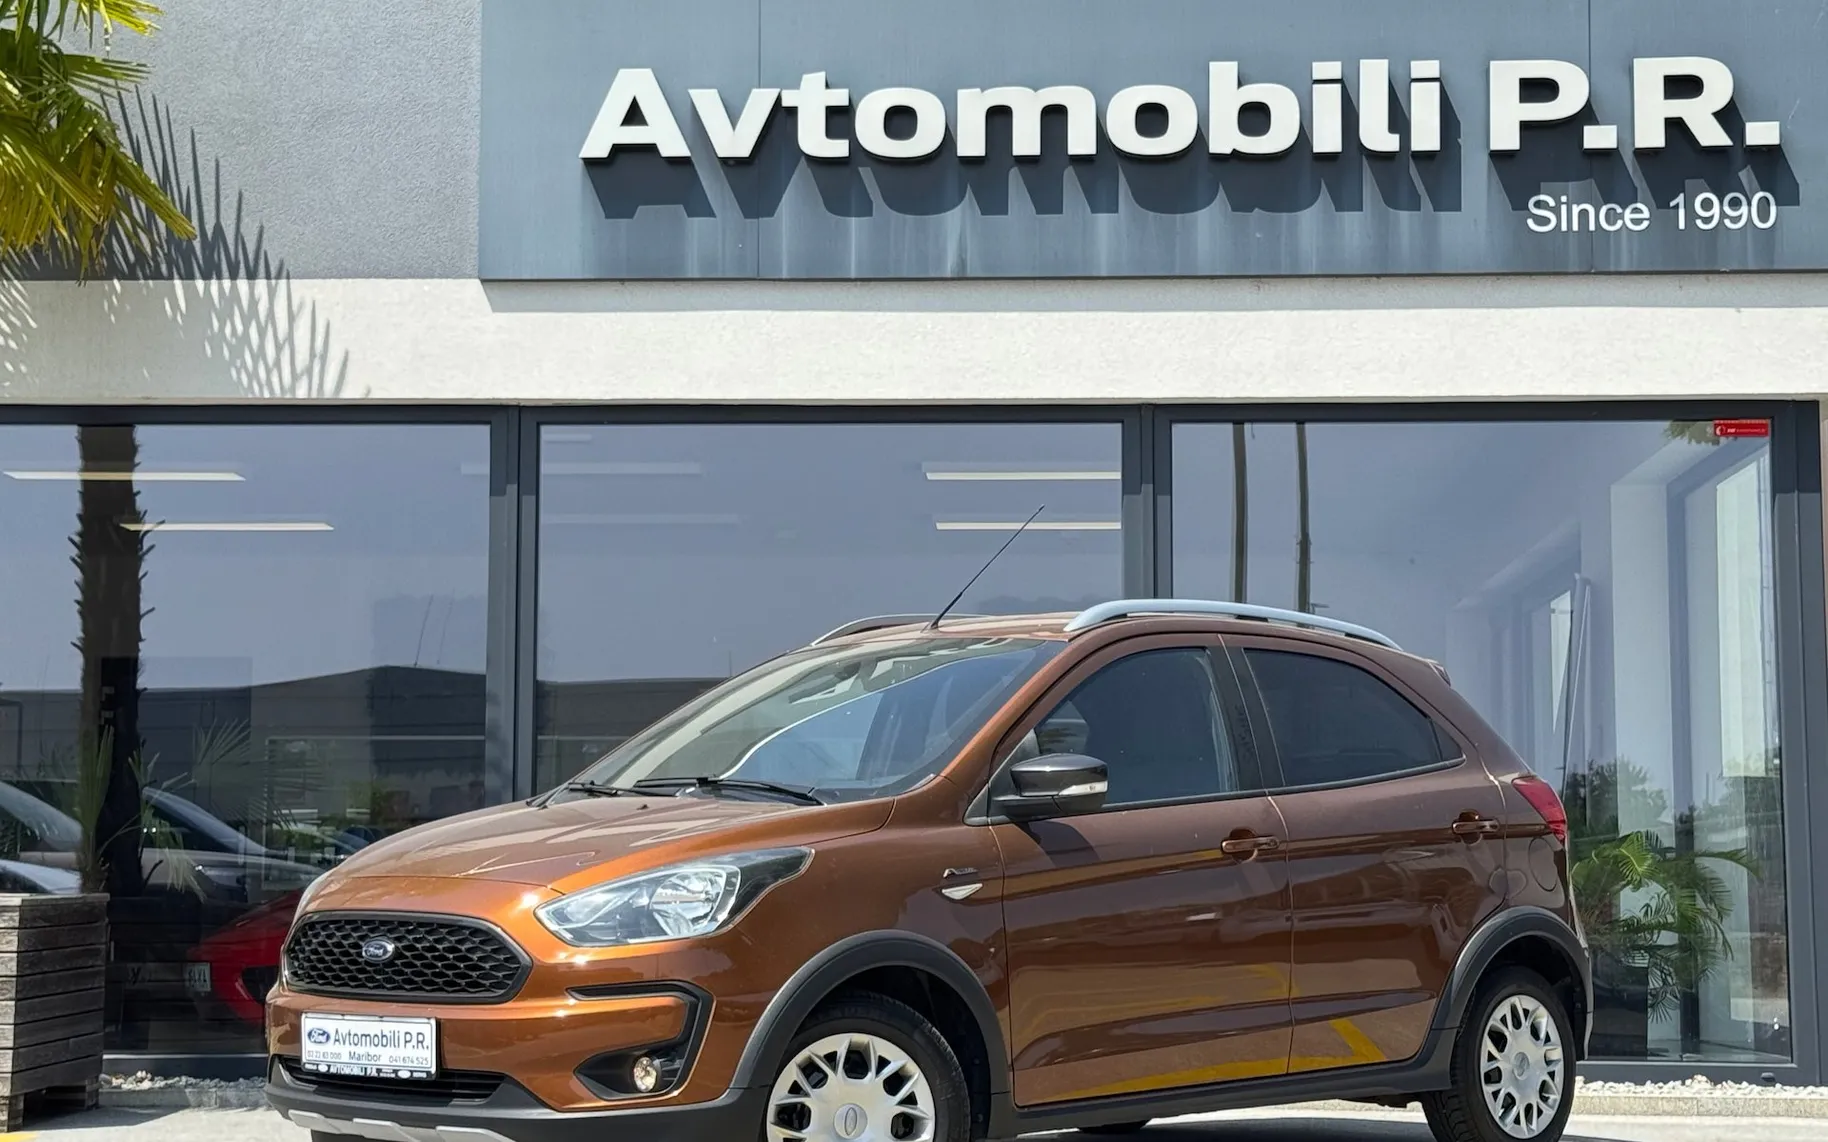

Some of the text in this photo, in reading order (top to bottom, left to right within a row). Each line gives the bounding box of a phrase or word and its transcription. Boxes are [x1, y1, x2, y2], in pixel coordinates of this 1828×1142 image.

[579, 56, 1780, 158] Avtomobili P.R.
[1526, 191, 1778, 233] Since 1990
[333, 1027, 429, 1050] Avtomobili P.R.
[349, 1050, 382, 1062] Maribor
